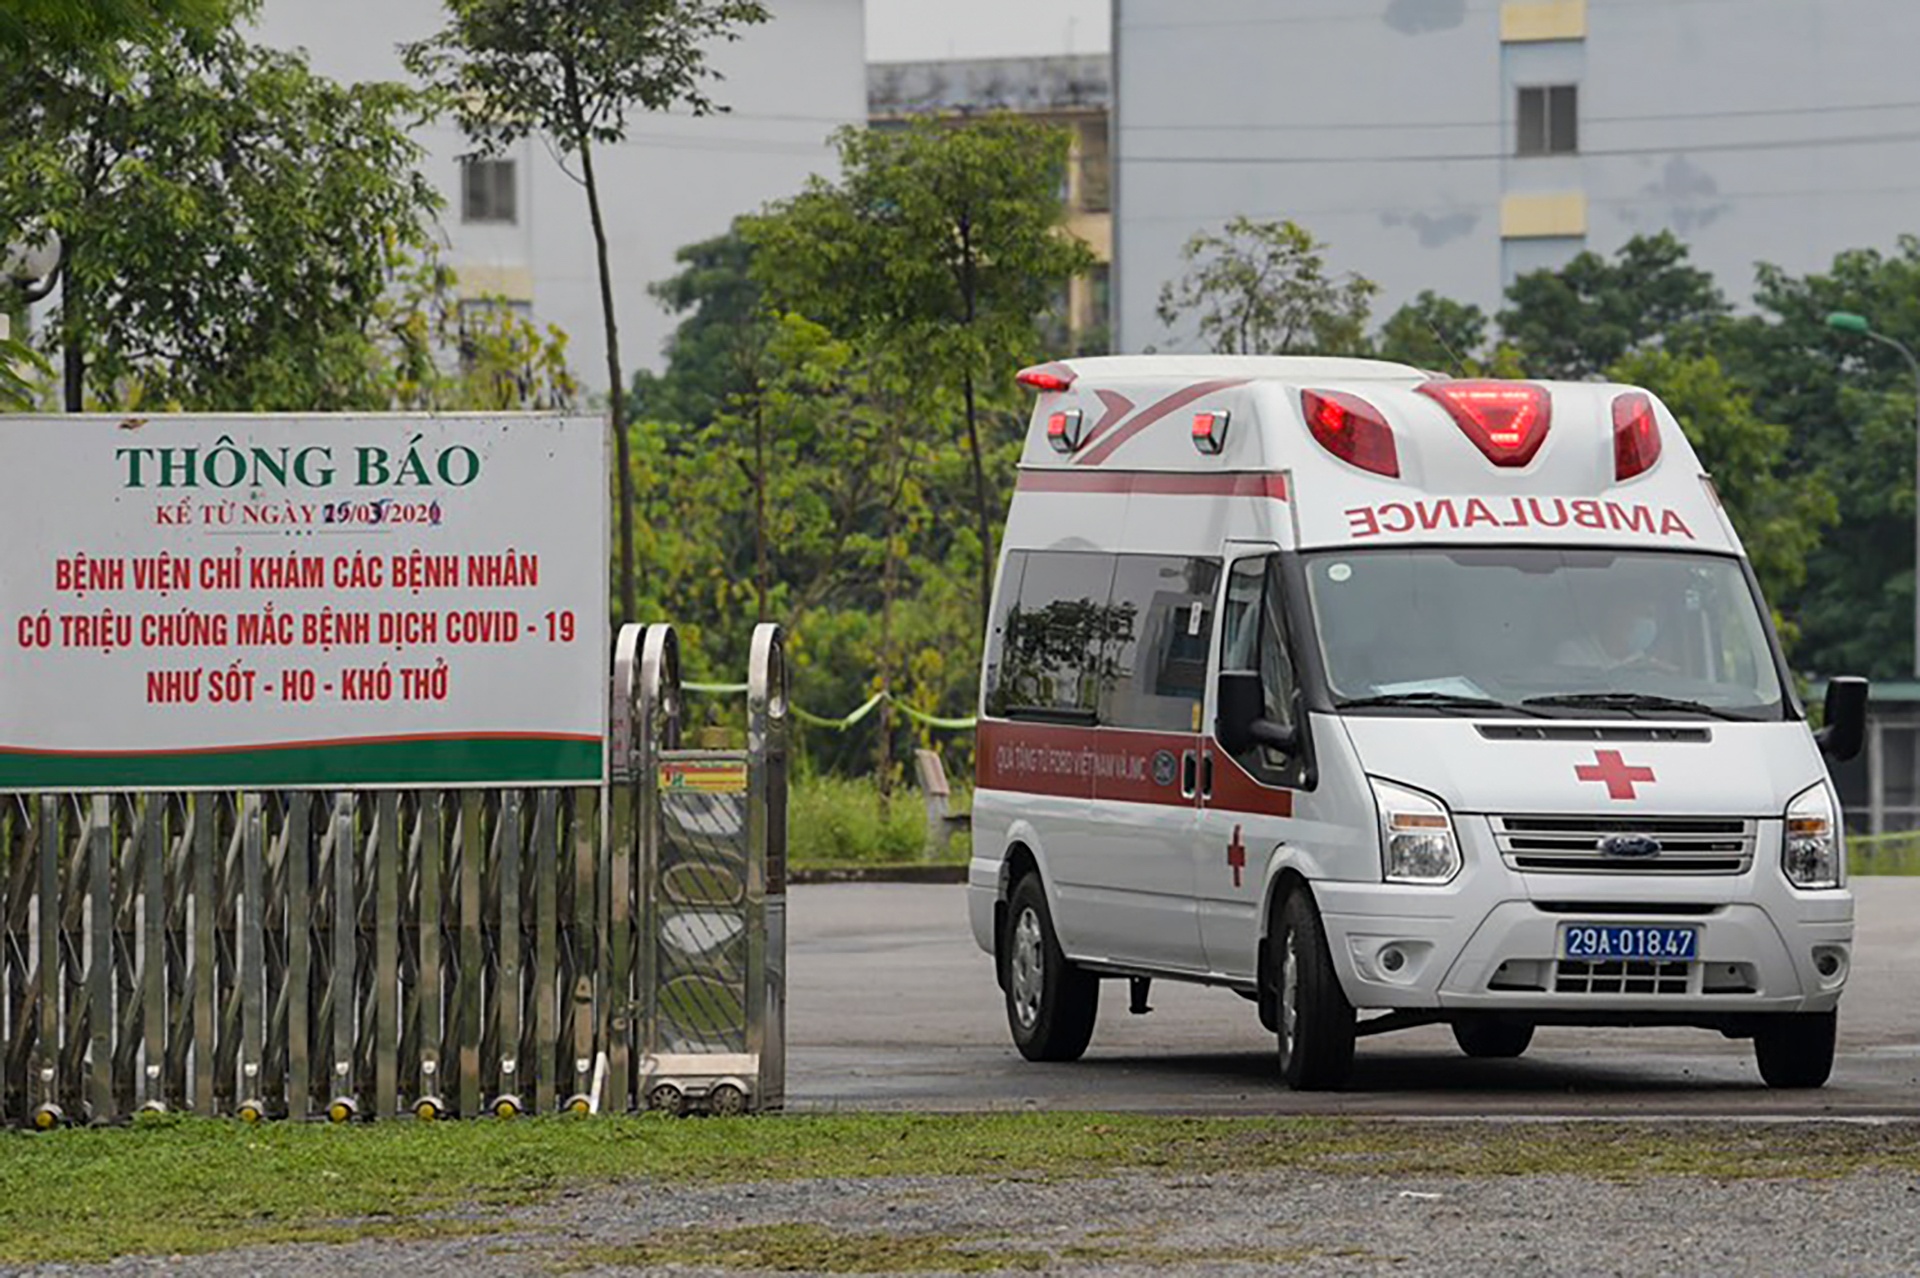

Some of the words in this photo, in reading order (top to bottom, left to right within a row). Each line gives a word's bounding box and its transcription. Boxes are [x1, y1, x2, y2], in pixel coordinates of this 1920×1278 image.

[116, 434, 336, 488] THÔNG
[354, 433, 480, 487] BÁO
[156, 497, 192, 525] KỂ
[199, 501, 235, 525] TỪ
[242, 503, 318, 526] NGÀY
[56, 552, 124, 598] BỆNH
[133, 551, 190, 597] VIỆN
[200, 547, 241, 589] CHỈ
[250, 550, 324, 589] KHÁM
[333, 549, 383, 587] CÁC
[392, 549, 459, 595] BỆNH
[467, 548, 538, 587] NHÂN
[18, 608, 51, 647] CÓ
[60, 608, 131, 654] TRIỆU
[141, 607, 227, 646] CHỨNG
[237, 601, 294, 645] MẮC
[302, 606, 370, 652] BỆNH
[379, 612, 437, 651] DỊCH
[446, 611, 518, 643] COVID
[545, 611, 575, 643] 19
[147, 667, 202, 703] NHƯ
[208, 658, 255, 702] SỐT
[282, 670, 315, 701] HO
[342, 661, 392, 701] KHÓ
[400, 657, 448, 700] THỞ
